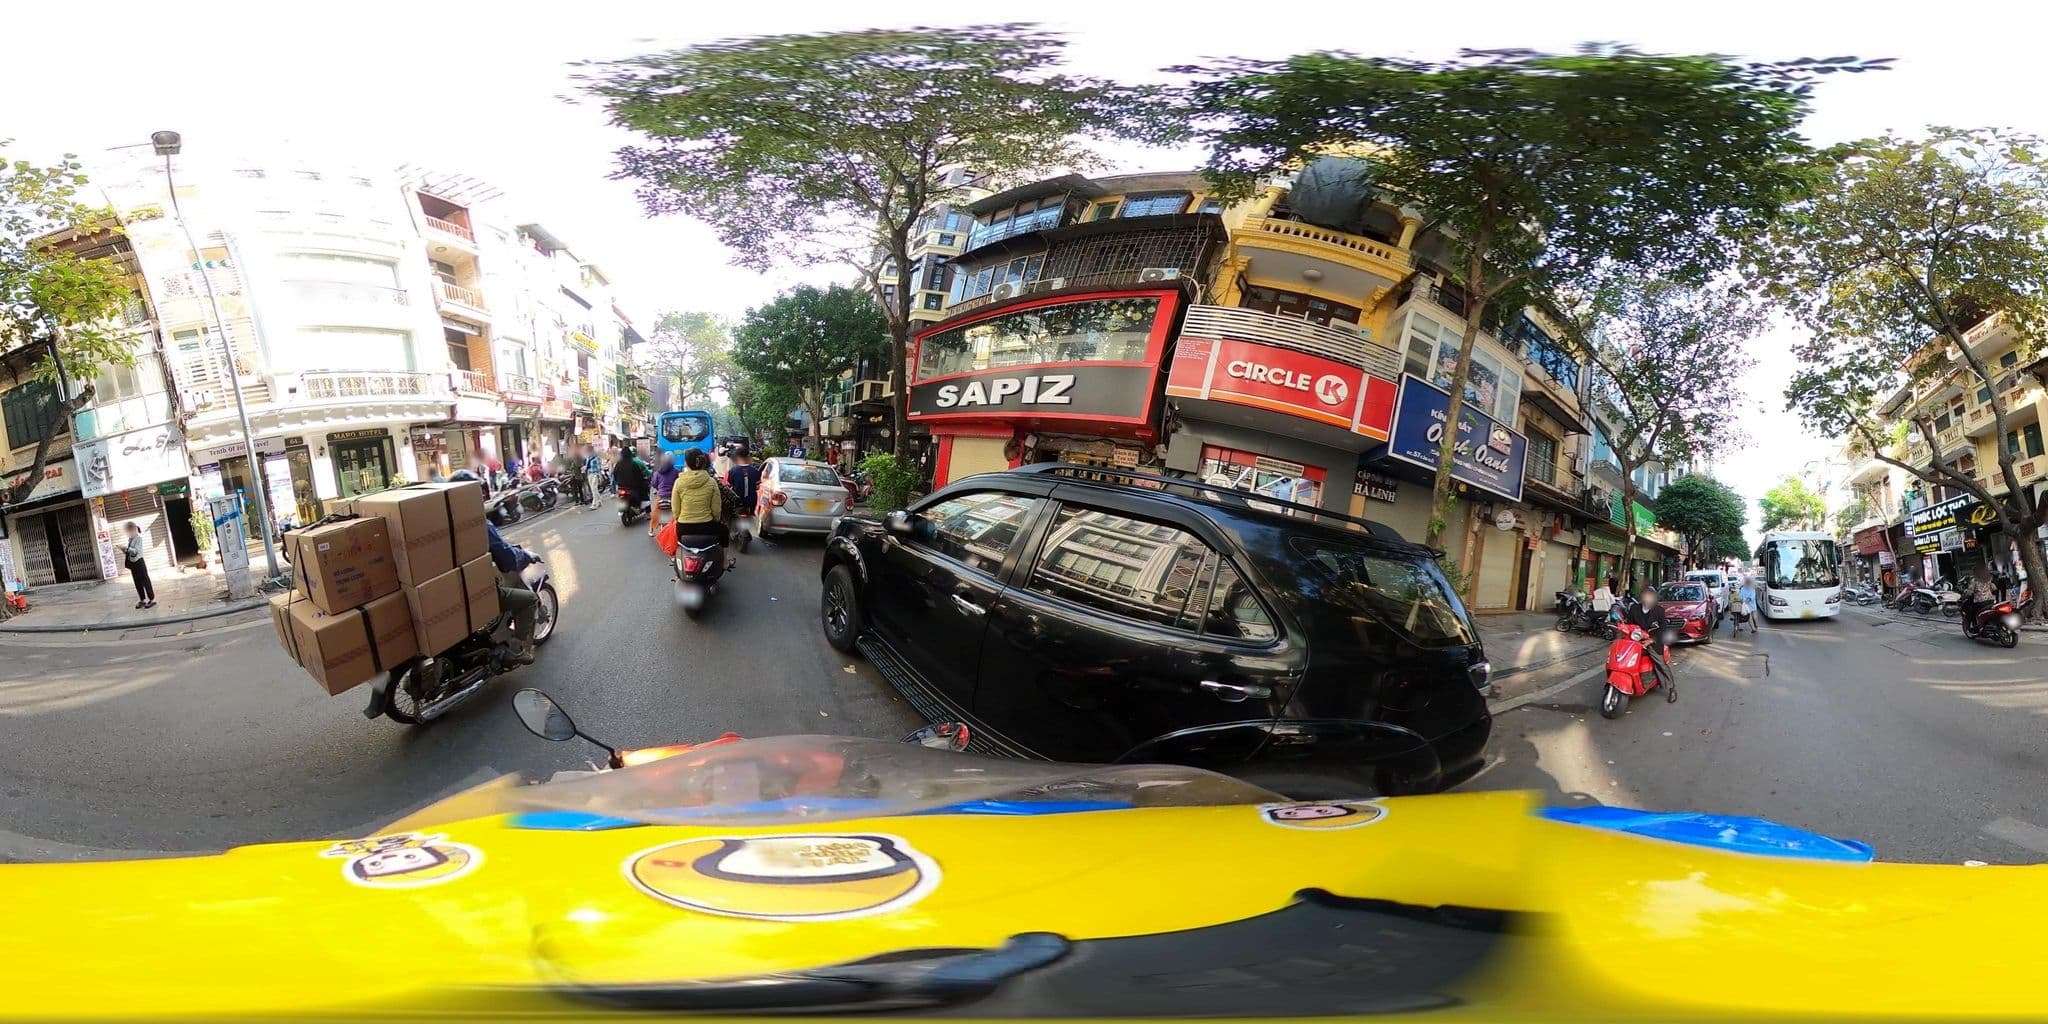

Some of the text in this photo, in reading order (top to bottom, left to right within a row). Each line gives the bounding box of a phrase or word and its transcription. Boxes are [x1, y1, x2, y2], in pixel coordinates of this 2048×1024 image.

[936, 374, 1076, 408] SAPIZ
[1227, 360, 1344, 404] CIRCLE K
[360, 428, 383, 437] HOTEL
[209, 447, 227, 456] Tenth
[1475, 444, 1511, 473] Oanh
[1354, 481, 1396, 503] HÀ LINH
